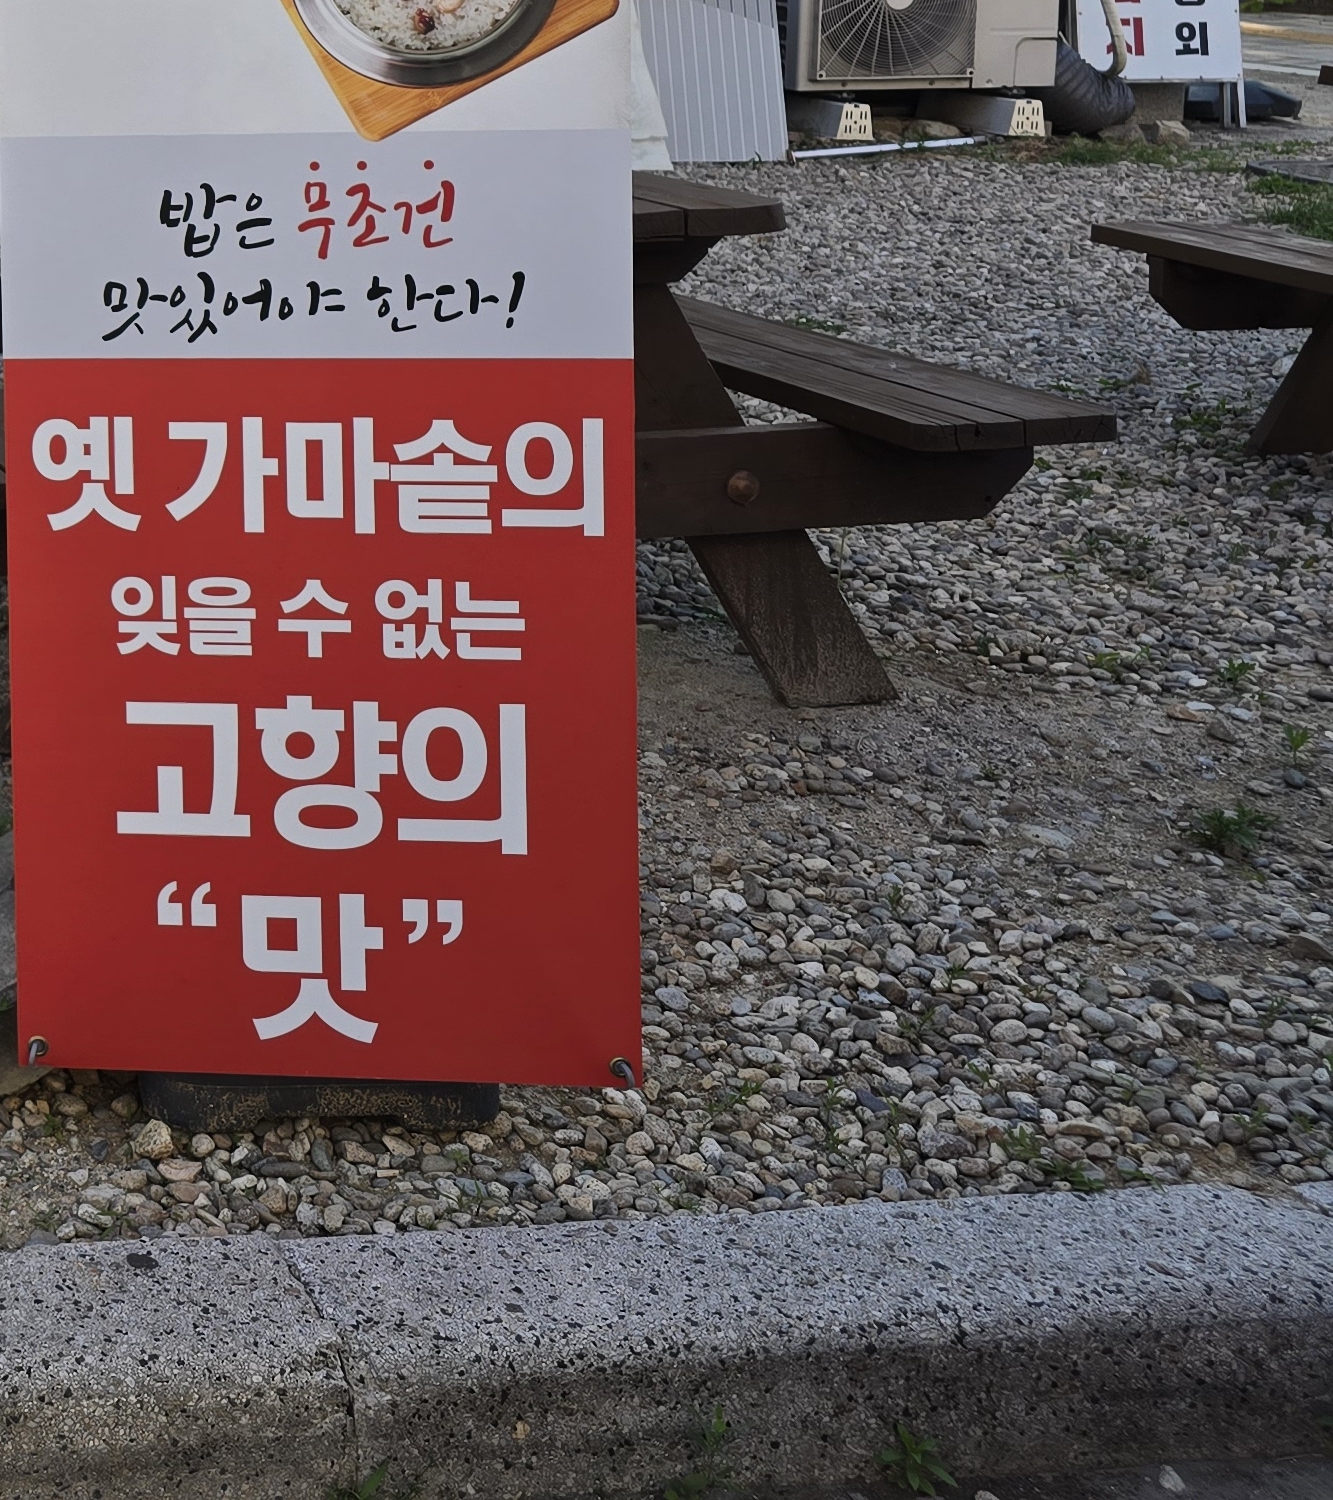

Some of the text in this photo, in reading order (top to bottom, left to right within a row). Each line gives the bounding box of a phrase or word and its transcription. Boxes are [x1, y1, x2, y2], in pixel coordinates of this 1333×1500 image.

[1174, 21, 1210, 57] 외
[159, 179, 457, 260] 밥은 무조건
[101, 271, 527, 344] 맛있어야 한다!
[31, 415, 606, 537] 옛 가마솥의
[110, 574, 527, 661] 잊을 수 없는
[115, 694, 529, 856] 고향의
